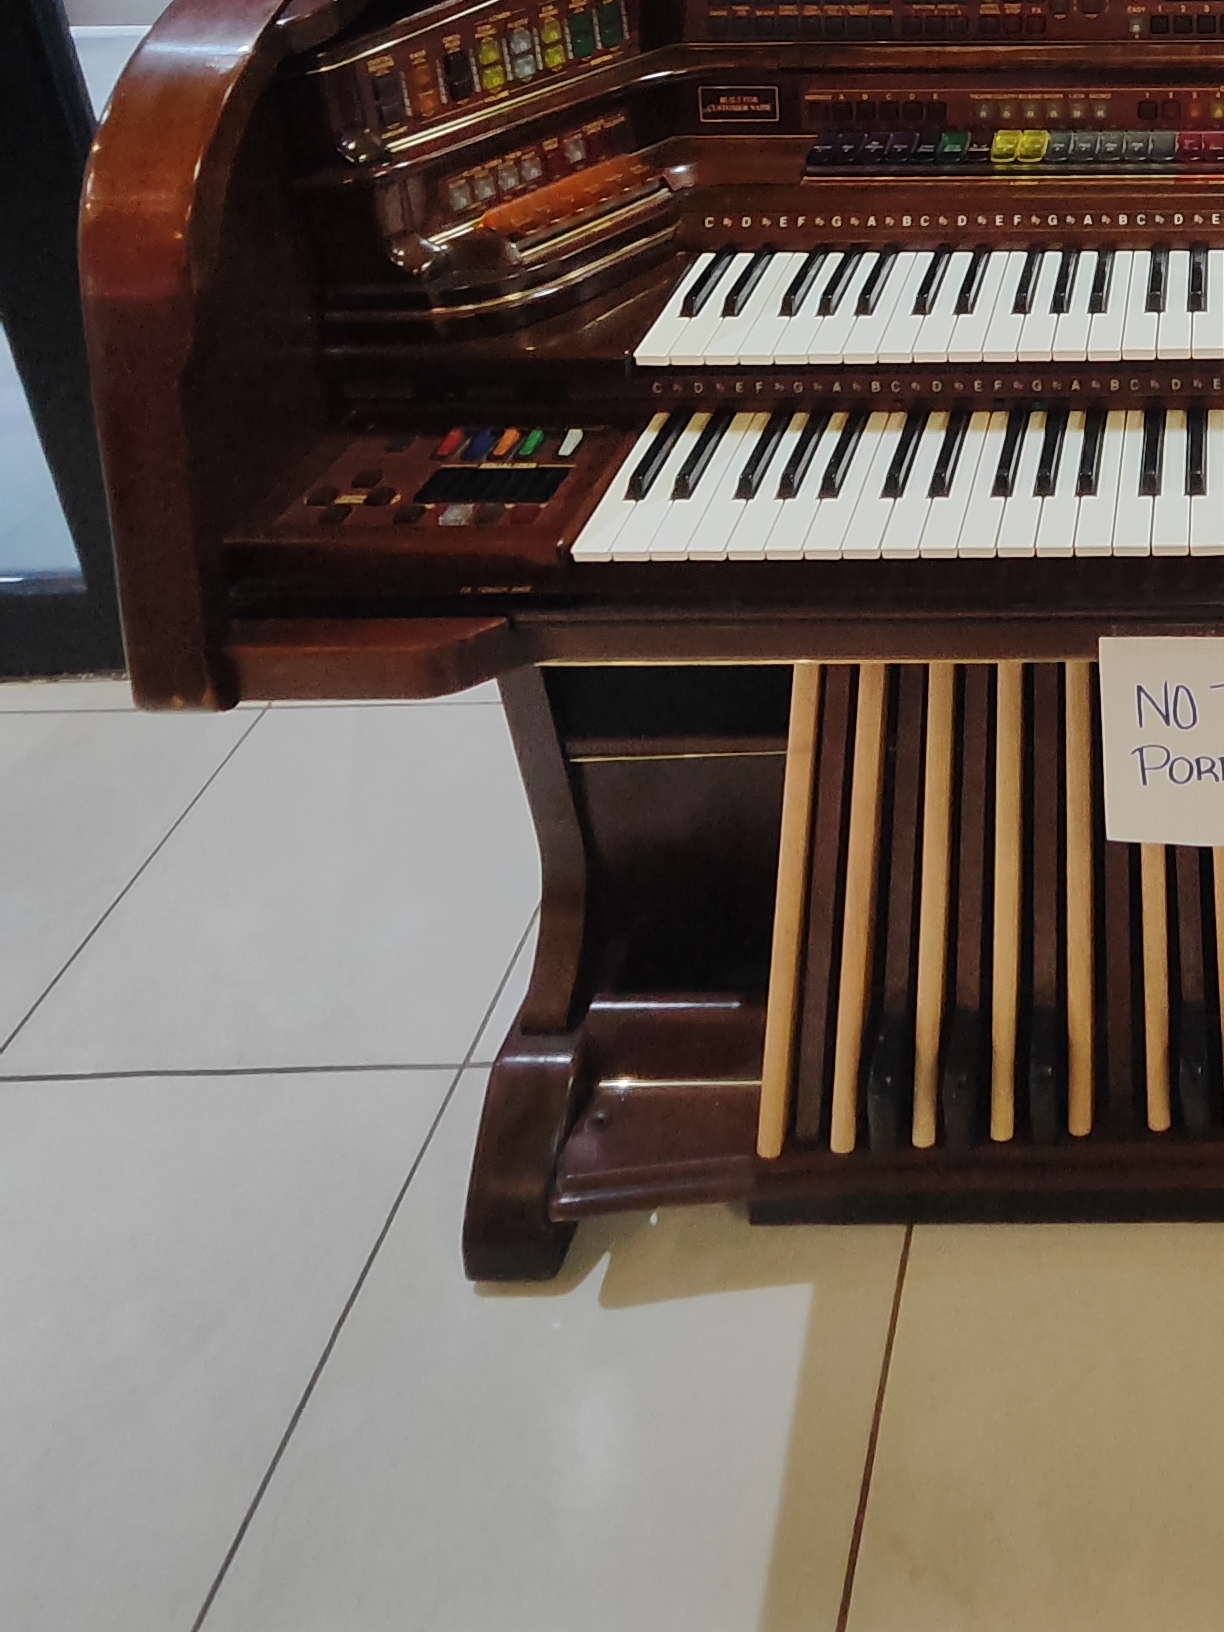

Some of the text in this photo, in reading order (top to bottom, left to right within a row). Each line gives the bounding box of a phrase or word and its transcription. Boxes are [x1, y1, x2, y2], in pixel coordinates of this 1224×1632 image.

[1157, 4, 1162, 12] 1
[1181, 4, 1187, 12] 2
[1203, 4, 1210, 12] 3
[705, 217, 714, 228] C
[742, 217, 751, 227] D
[780, 216, 787, 227] E
[798, 216, 805, 226] F
[832, 216, 841, 227] G
[868, 216, 876, 226] A
[903, 216, 911, 226] B
[920, 216, 929, 226] C
[957, 215, 967, 226] D
[996, 215, 1003, 226] E
[1014, 215, 1021, 225] F
[1048, 215, 1057, 225] G
[1084, 215, 1092, 224] A
[1119, 215, 1127, 225] B
[1137, 214, 1145, 225] C
[1174, 214, 1183, 224] D
[1212, 214, 1220, 224] E
[653, 382, 661, 393] C
[694, 382, 703, 393] D
[736, 382, 743, 392] E
[756, 382, 762, 392] F
[793, 382, 803, 393] G
[833, 382, 841, 391] A
[871, 381, 880, 392] B
[891, 381, 900, 392] C
[932, 381, 941, 392] D
[974, 380, 981, 391] E
[994, 380, 1001, 390] F
[1032, 380, 1042, 391] G
[1072, 380, 1080, 390] A
[1111, 379, 1119, 391] B
[1130, 379, 1138, 390] C
[1172, 379, 1181, 390] D
[1213, 379, 1220, 389] E
[1136, 680, 1197, 730] NO
